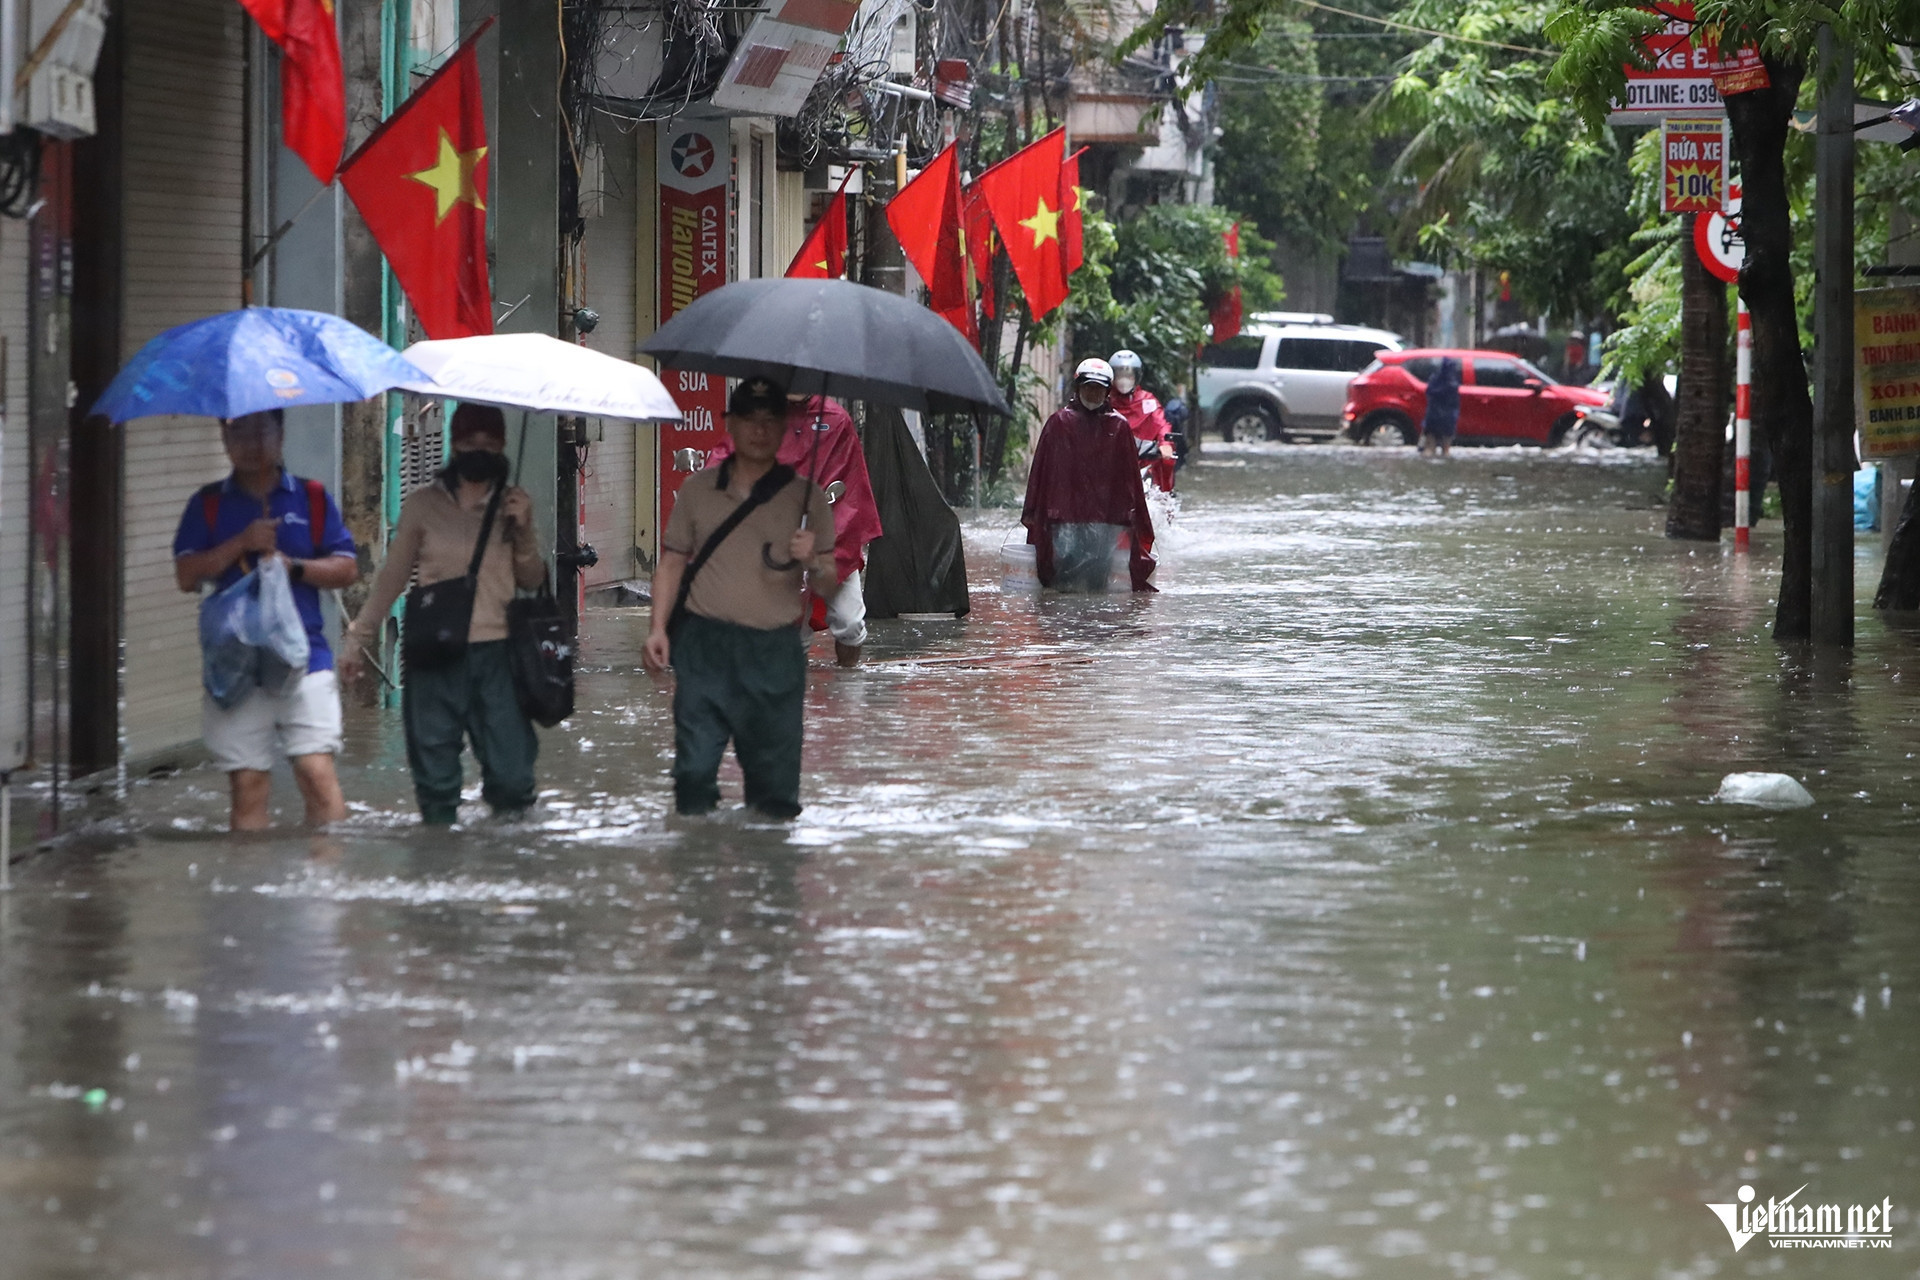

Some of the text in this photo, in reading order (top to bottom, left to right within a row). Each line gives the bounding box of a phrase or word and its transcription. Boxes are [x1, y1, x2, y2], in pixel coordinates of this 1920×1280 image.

[1627, 84, 1684, 104] OTLINE:
[1668, 135, 1721, 160] RỬA XE
[1676, 174, 1714, 197] 10k
[701, 205, 717, 275] CALTEX
